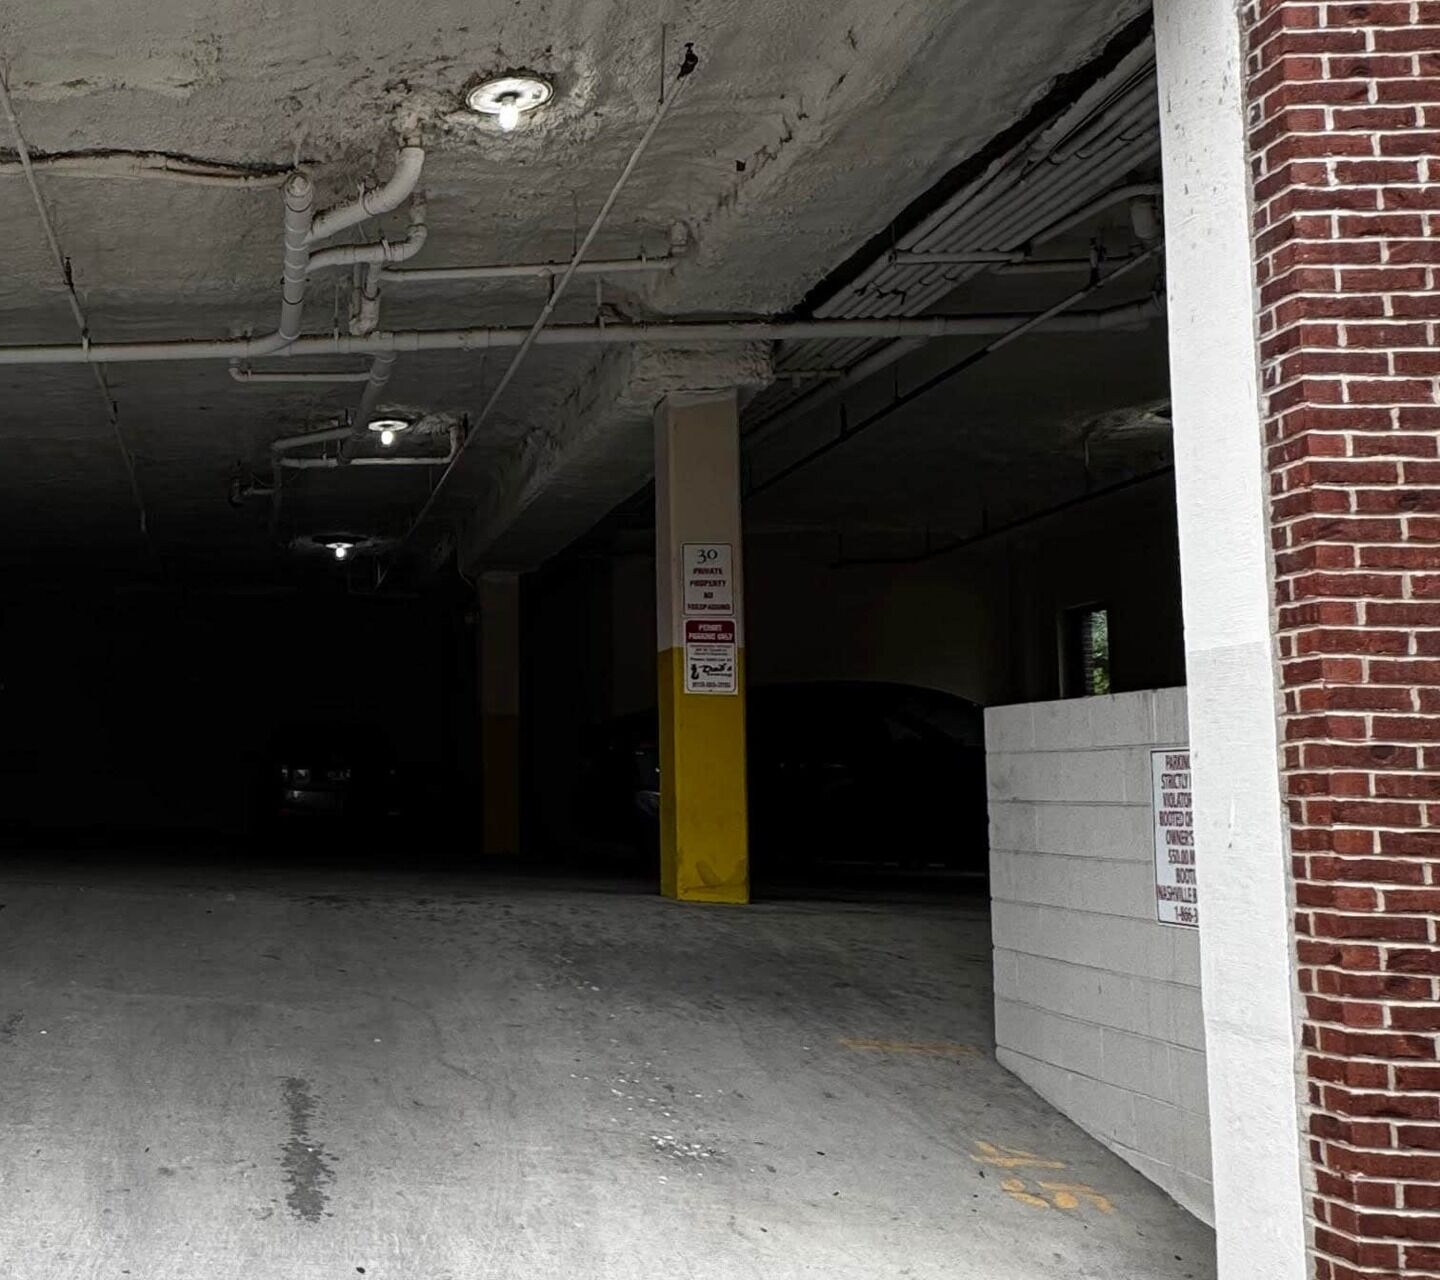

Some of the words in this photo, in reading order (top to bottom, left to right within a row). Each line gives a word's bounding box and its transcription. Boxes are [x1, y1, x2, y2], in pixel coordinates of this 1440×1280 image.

[696, 549, 718, 565] 30
[1165, 754, 1190, 770] PARKIN
[1161, 773, 1188, 789] STRICTLY
[1163, 792, 1192, 808] VIOLATOR
[1159, 811, 1184, 826] BOOTED
[1168, 849, 1188, 865] $50.00
[1176, 867, 1197, 885] BOOTI
[1156, 885, 1192, 902] NASHVILLE
[1174, 906, 1199, 923] 1-866-3
